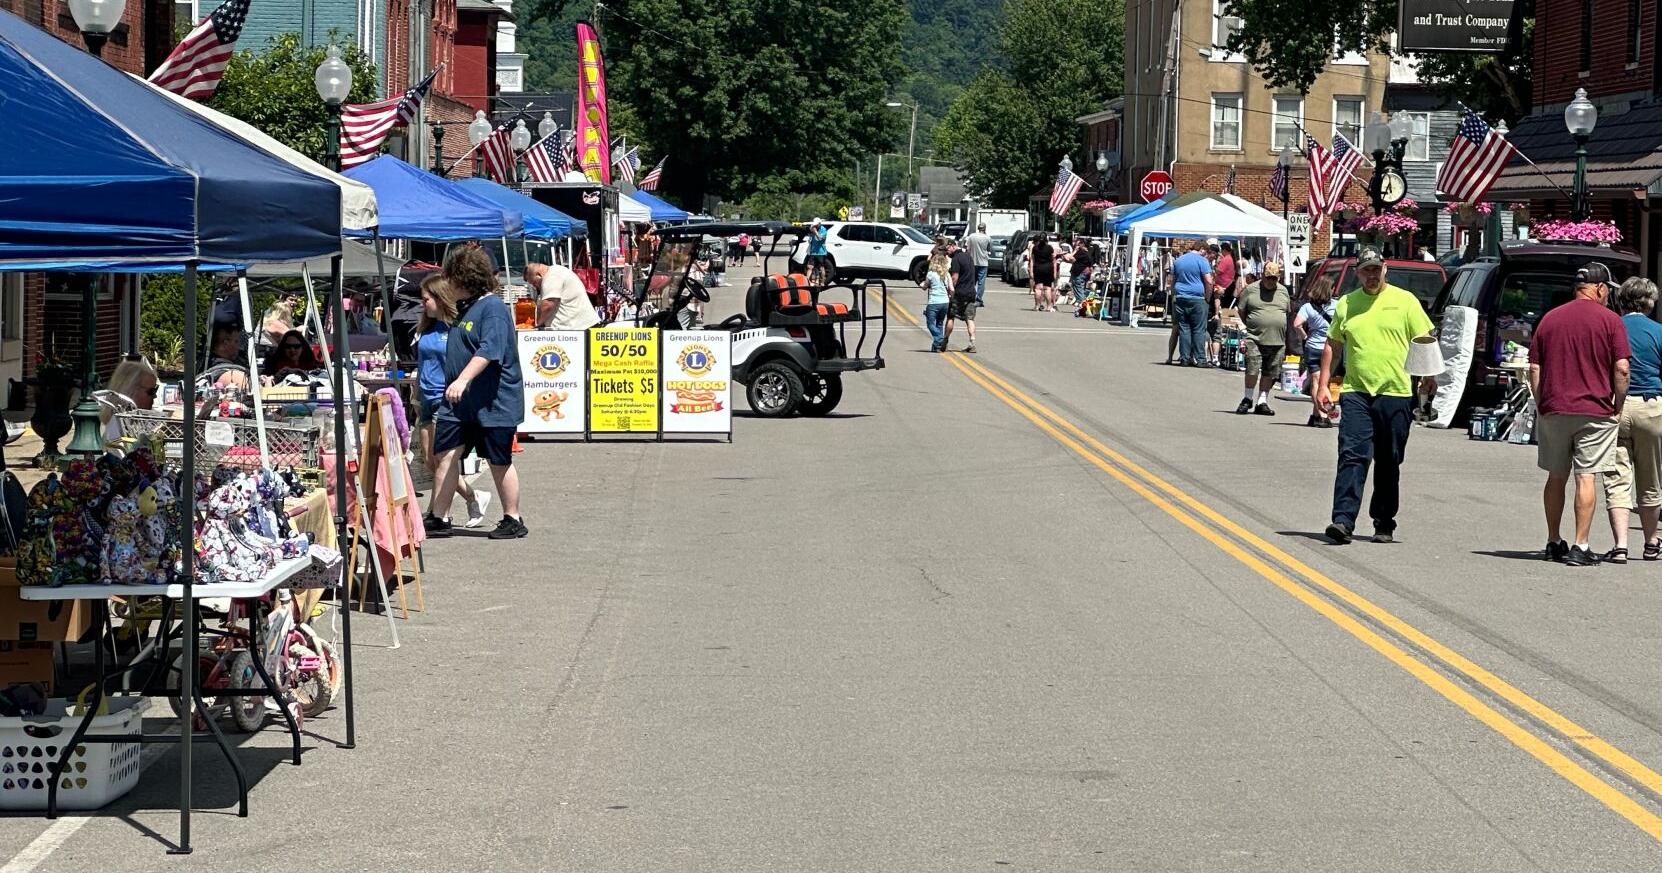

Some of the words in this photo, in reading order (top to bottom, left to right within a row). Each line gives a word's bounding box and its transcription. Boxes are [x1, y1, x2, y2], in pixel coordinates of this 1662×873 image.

[1414, 13, 1432, 25] and
[1435, 13, 1462, 26] Trust
[1466, 14, 1510, 29] Company
[1470, 36, 1494, 44] Member
[1143, 181, 1173, 195] STOP
[1290, 215, 1309, 224] ONE
[1290, 225, 1308, 233] WAY
[595, 331, 629, 341] GREENUP
[631, 331, 652, 341] LIONS
[669, 334, 702, 342] Greenup
[703, 334, 724, 342] Lions
[540, 345, 561, 353] LIONS
[601, 344, 647, 358] 50/50
[686, 344, 707, 353] LIONS
[544, 353, 557, 368] L
[690, 353, 703, 368] L
[524, 381, 578, 390] Hamburgers
[593, 378, 634, 394] Tickets
[640, 376, 654, 395] $5
[667, 380, 694, 391] HOT
[695, 380, 727, 391] DOGS
[678, 403, 693, 413] All
[694, 402, 716, 412] Beef
